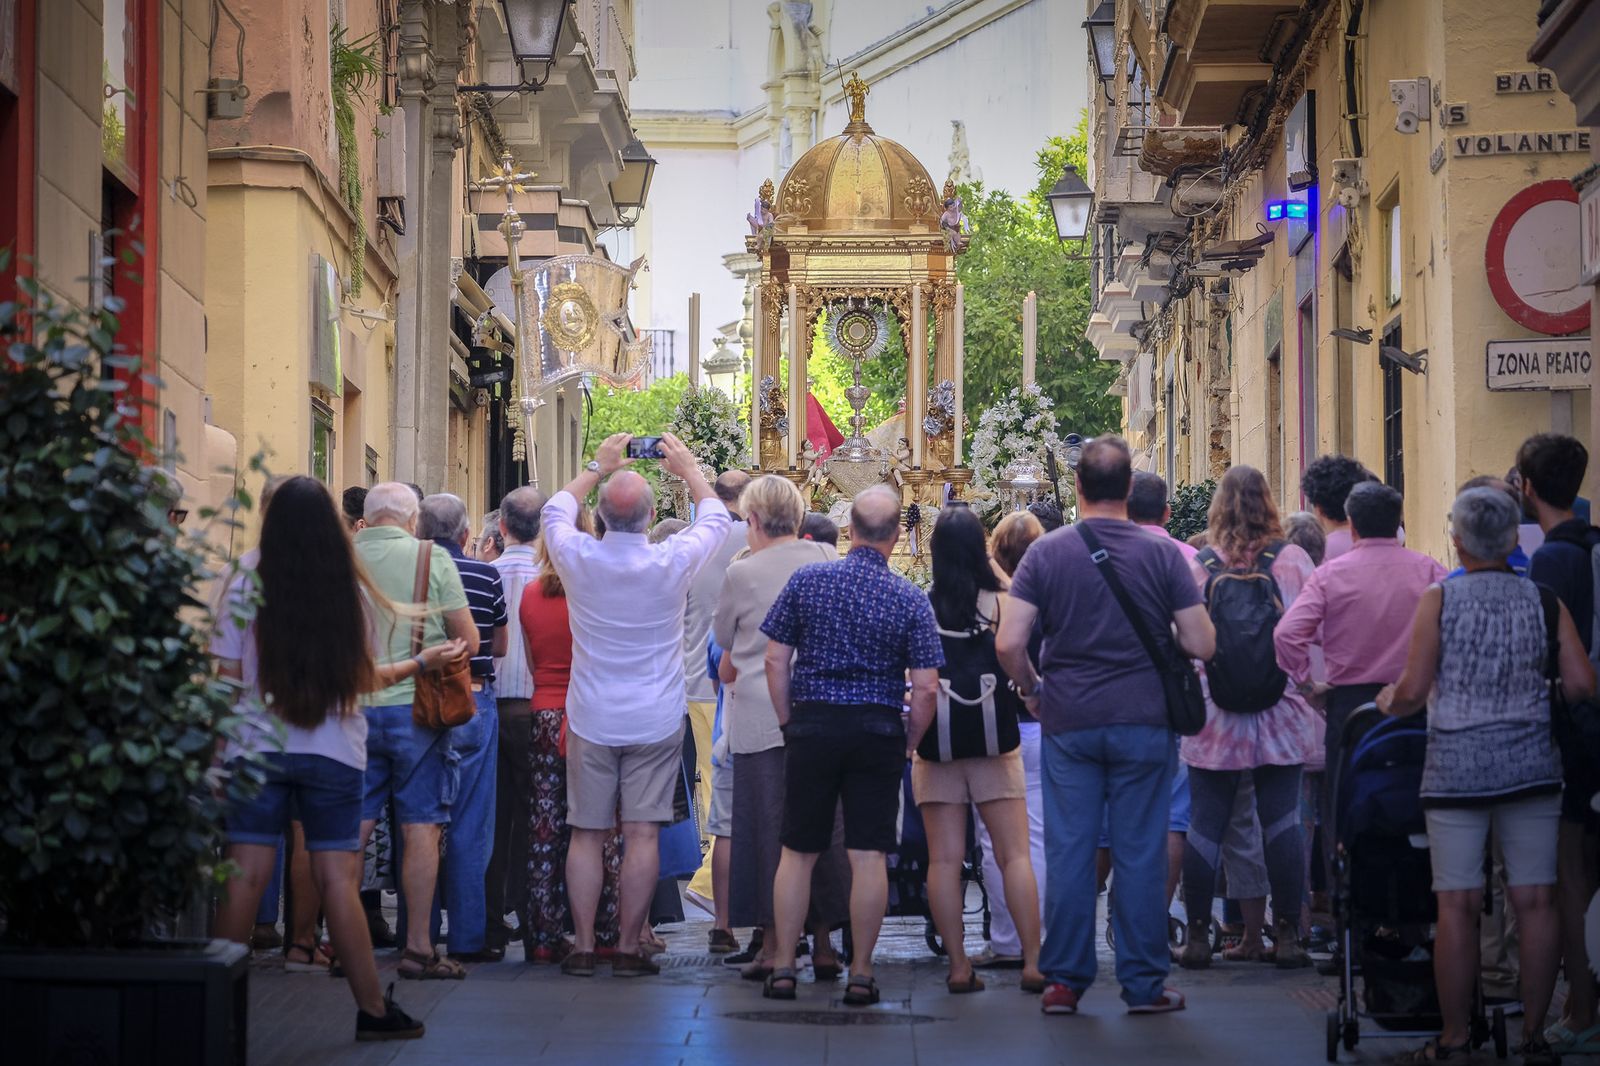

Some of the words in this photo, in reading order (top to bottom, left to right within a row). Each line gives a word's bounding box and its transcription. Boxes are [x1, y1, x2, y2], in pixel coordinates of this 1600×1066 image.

[1496, 73, 1552, 91] BAR
[1457, 132, 1590, 154] VOLANTE
[1497, 352, 1541, 375] ZONA
